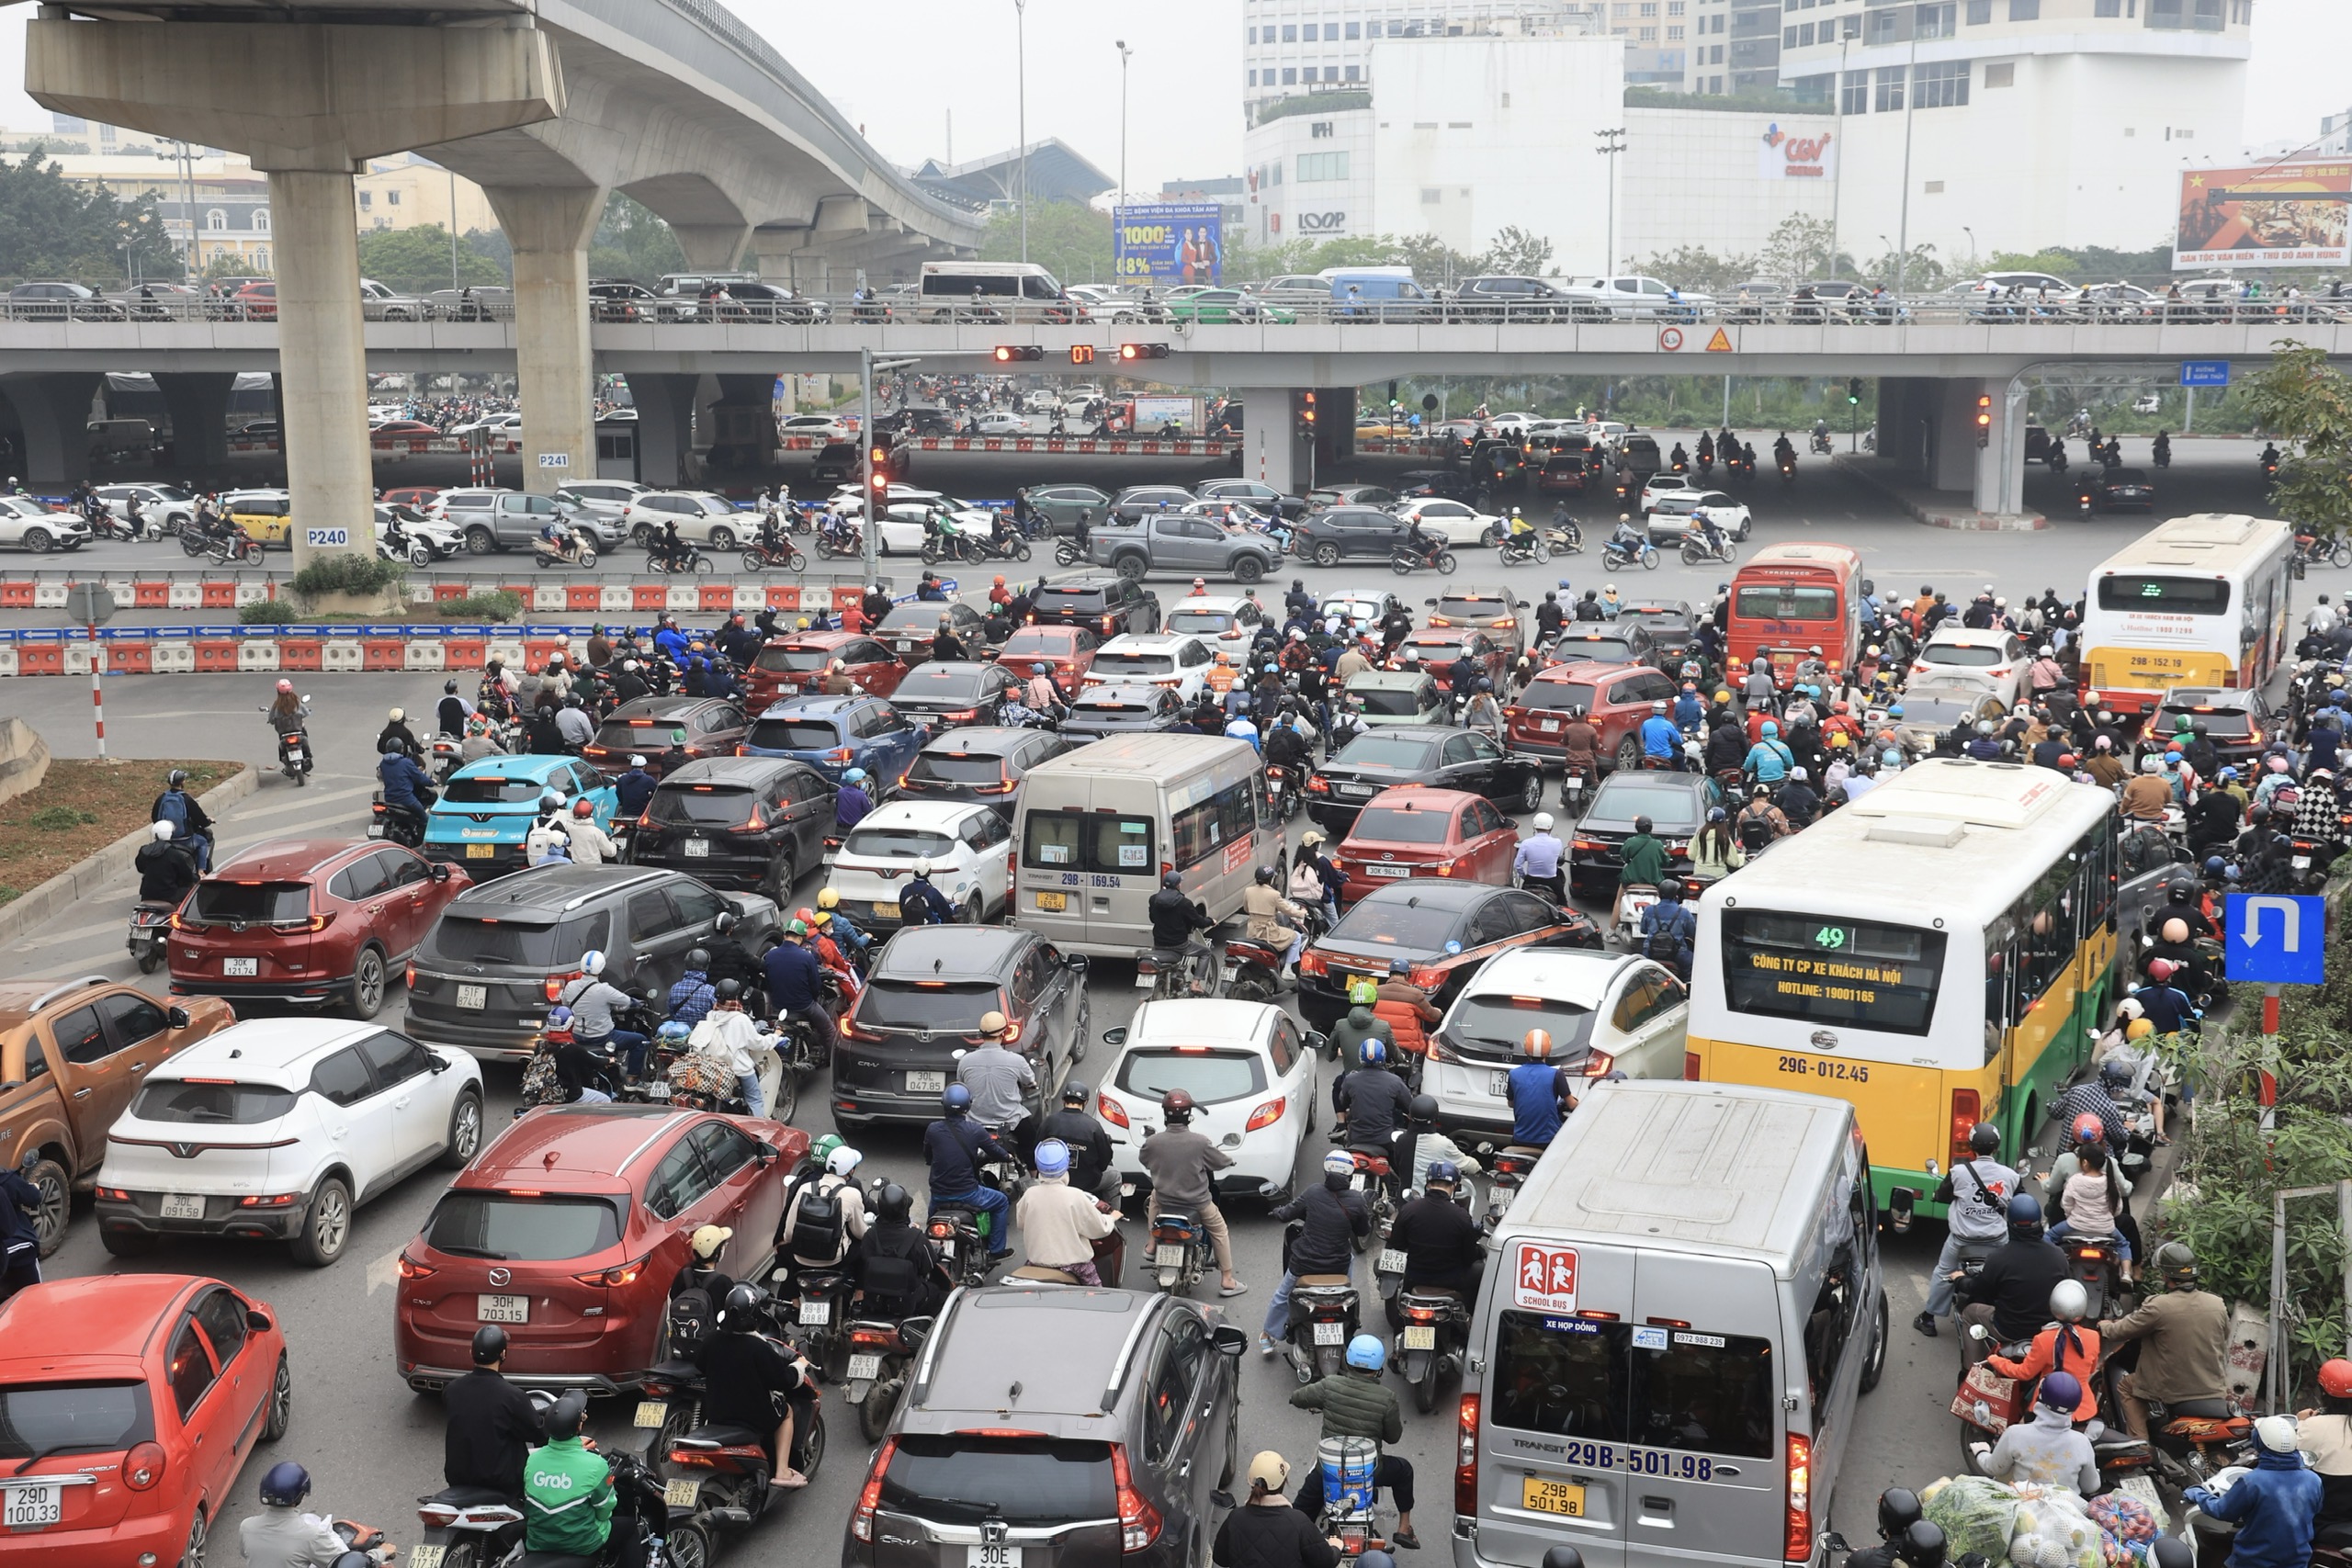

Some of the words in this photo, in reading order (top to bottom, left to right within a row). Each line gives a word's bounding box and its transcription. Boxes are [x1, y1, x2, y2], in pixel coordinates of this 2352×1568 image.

[1312, 122, 1333, 138] IPH
[1785, 136, 1826, 161] CGV
[1298, 212, 1345, 229] LOOP
[2295, 251, 2314, 259] ANH
[1072, 346, 1092, 363] 07
[540, 456, 567, 466] P241
[309, 530, 345, 545] P240
[1091, 874, 1121, 888] 169.54
[1040, 900, 1063, 909] 169.54
[1815, 927, 1844, 948] 49
[232, 958, 248, 966] 30K
[228, 966, 254, 976] 121.74
[1752, 953, 1781, 971] CÔNG
[1782, 957, 1794, 971] TY
[1796, 958, 1811, 973] CP
[1813, 960, 1826, 975] XE
[1828, 959, 1863, 978] KHÁCH
[1865, 963, 1880, 980] HÀ
[1882, 966, 1902, 984] NỘI
[464, 986, 479, 998] 51F
[1778, 981, 1822, 998] HOTLINE:
[1825, 985, 1874, 1003] 19001165
[458, 996, 484, 1009] 874.42
[917, 1072, 933, 1081] 30L
[910, 1081, 941, 1091] 047.85
[175, 1196, 193, 1207] 30L
[164, 1206, 199, 1218] 091.58
[1159, 1256, 1179, 1265] 5731
[1380, 1259, 1404, 1271] 354.16
[492, 1296, 514, 1307] 30H
[1523, 1295, 1550, 1307] SCHOOL
[1553, 1299, 1567, 1309] BUS
[483, 1308, 523, 1321] 703.15
[800, 1314, 826, 1323] 588.84
[1546, 1320, 1556, 1328] XE
[1557, 1321, 1574, 1331] HỢP
[1575, 1320, 1597, 1332] ĐỒNG
[1316, 1334, 1342, 1344] 960.17
[1406, 1337, 1431, 1348] 432.51
[1676, 1334, 1693, 1342] 0972
[1694, 1336, 1708, 1344] 988
[1709, 1337, 1723, 1346] 235
[848, 1367, 876, 1378] 081.76
[636, 1414, 662, 1426] 568.47
[1512, 1438, 1566, 1455] TRANSIT
[1566, 1441, 1713, 1482] 29B-501.98
[533, 1471, 572, 1490] Grab
[17, 1487, 48, 1506] 29D
[1541, 1483, 1567, 1498] 29B
[669, 1493, 691, 1505] 1347
[1530, 1495, 1577, 1514] 501.98
[7, 1505, 59, 1524] 100.33
[980, 1547, 1010, 1564] 30E
